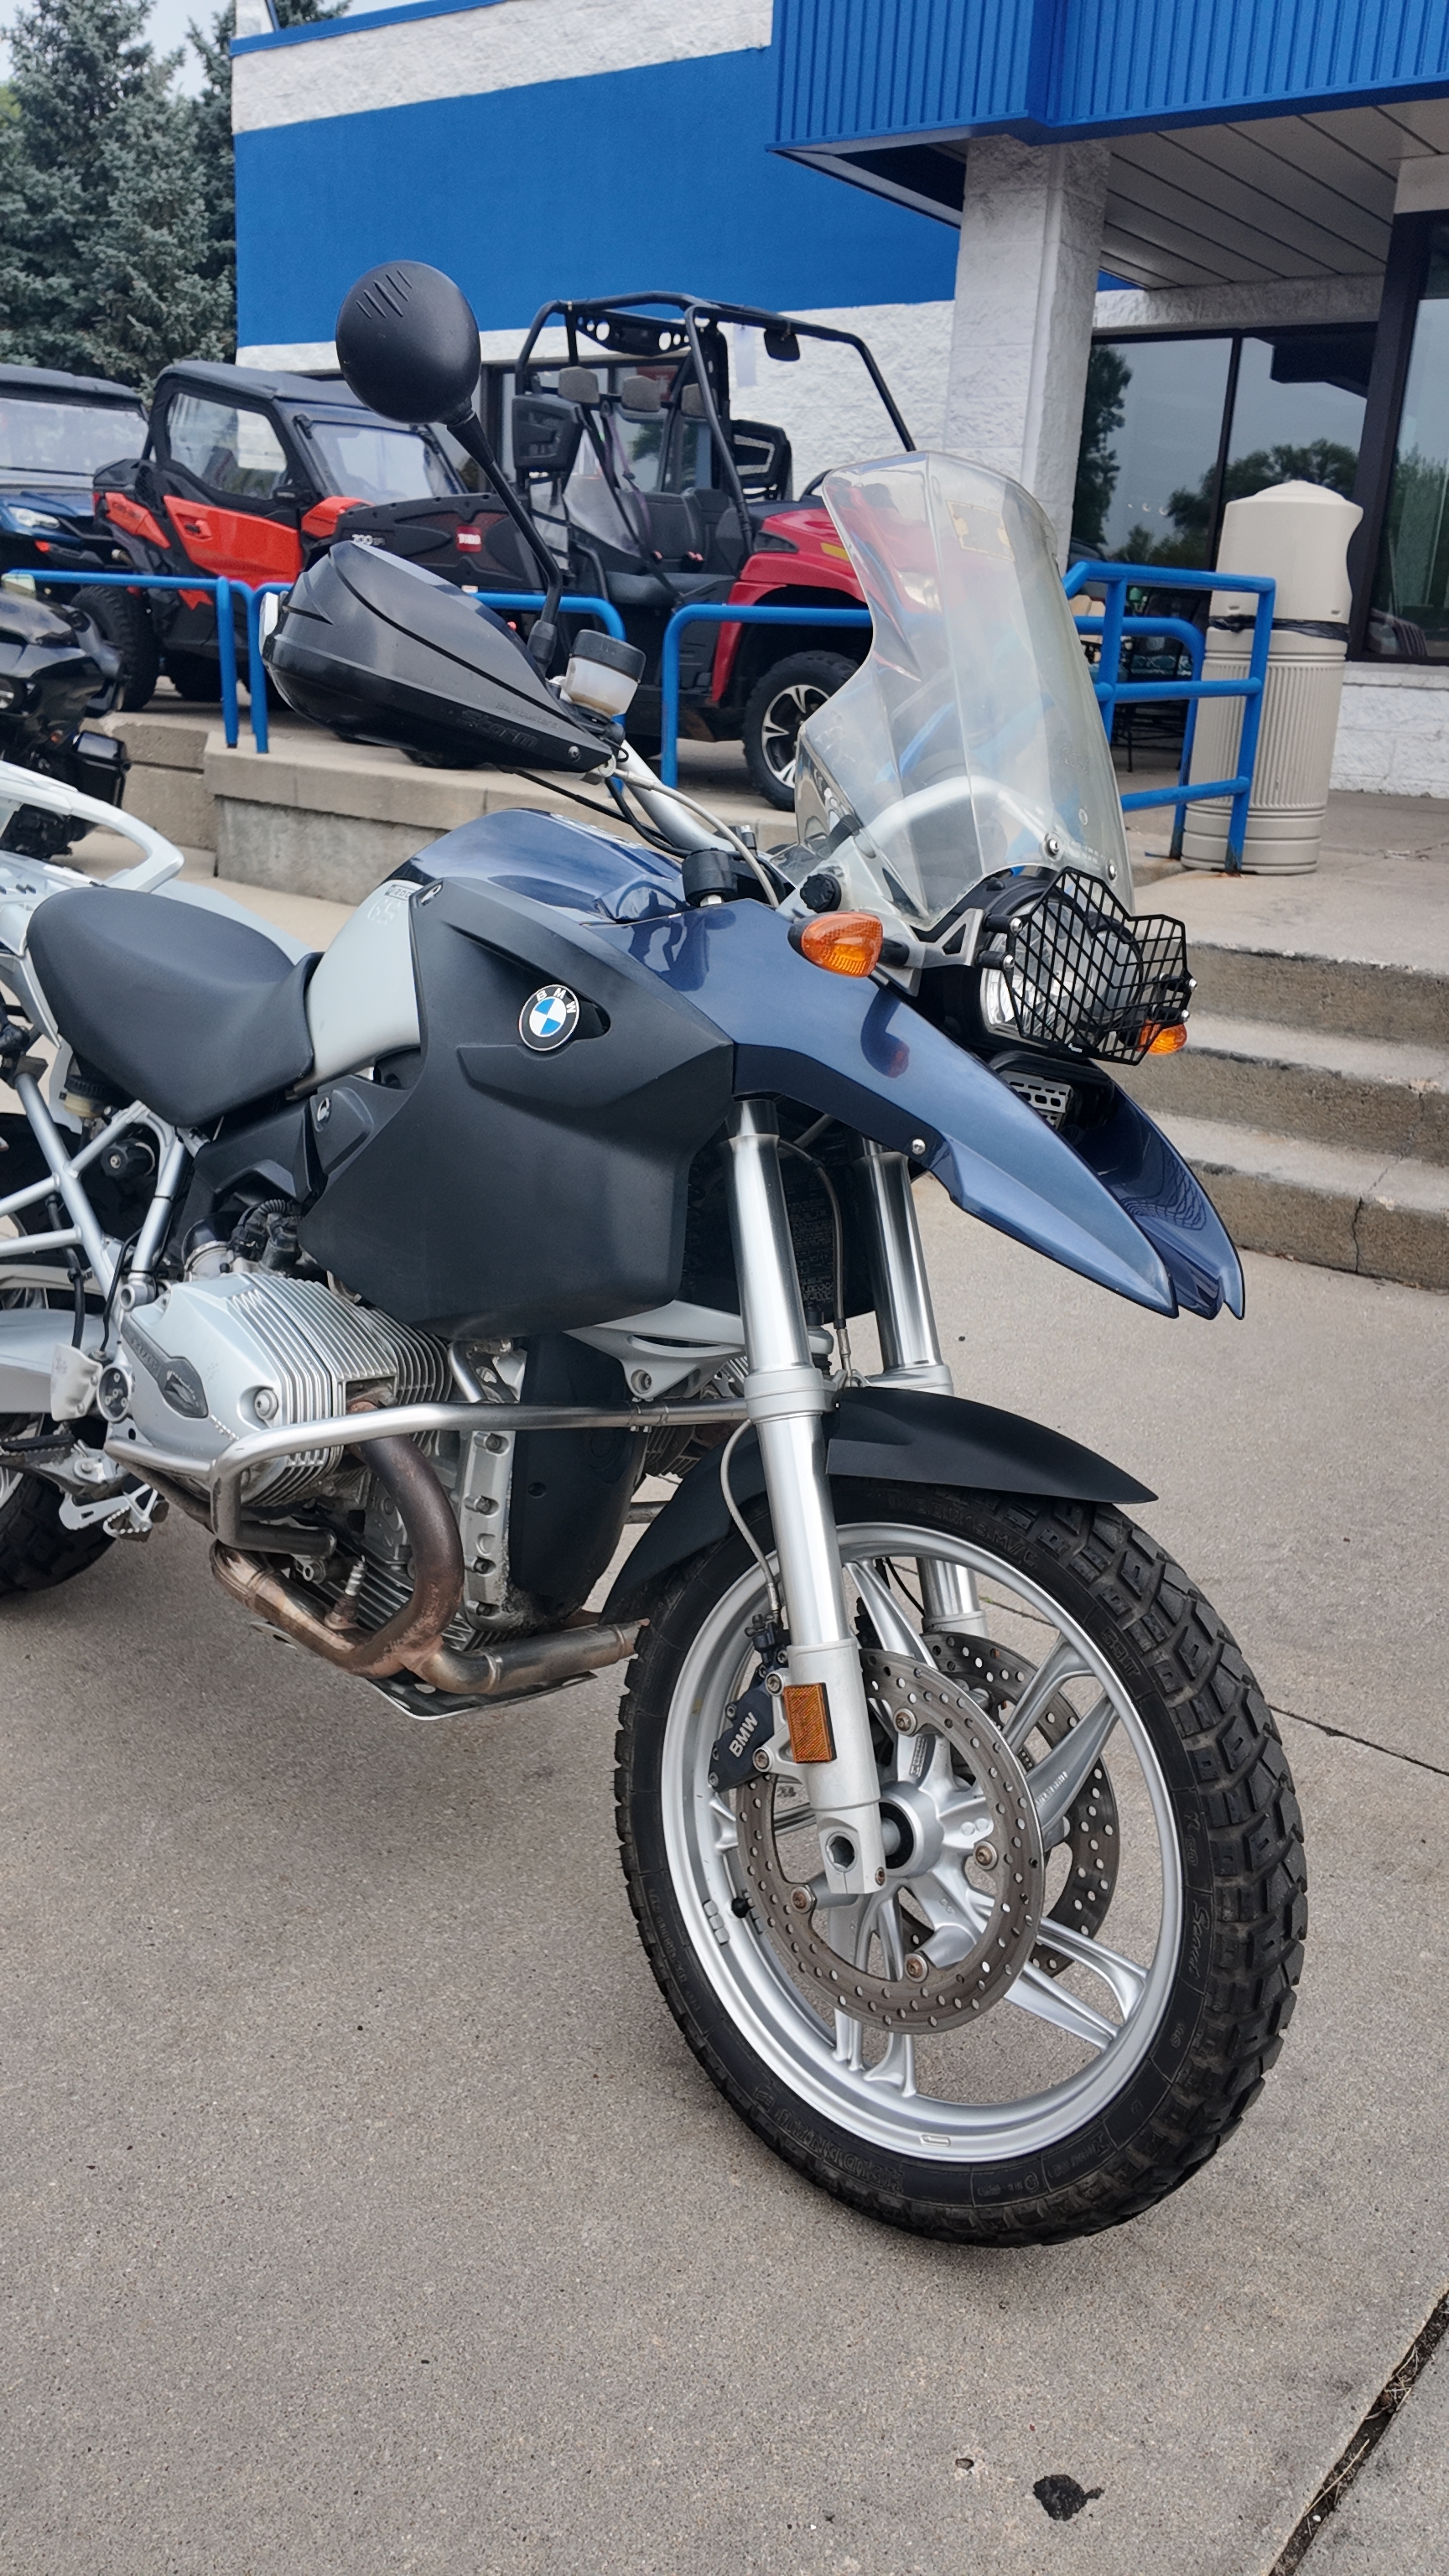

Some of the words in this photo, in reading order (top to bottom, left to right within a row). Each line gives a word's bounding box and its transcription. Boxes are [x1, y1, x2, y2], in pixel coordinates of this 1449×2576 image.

[457, 709, 539, 748] Storm
[536, 987, 577, 1014] BMW
[1101, 1627, 1141, 1676] 59T
[729, 1711, 758, 1758] BMW
[1188, 1899, 1210, 1979] Scout
[775, 2107, 905, 2194] HEIDENAU
